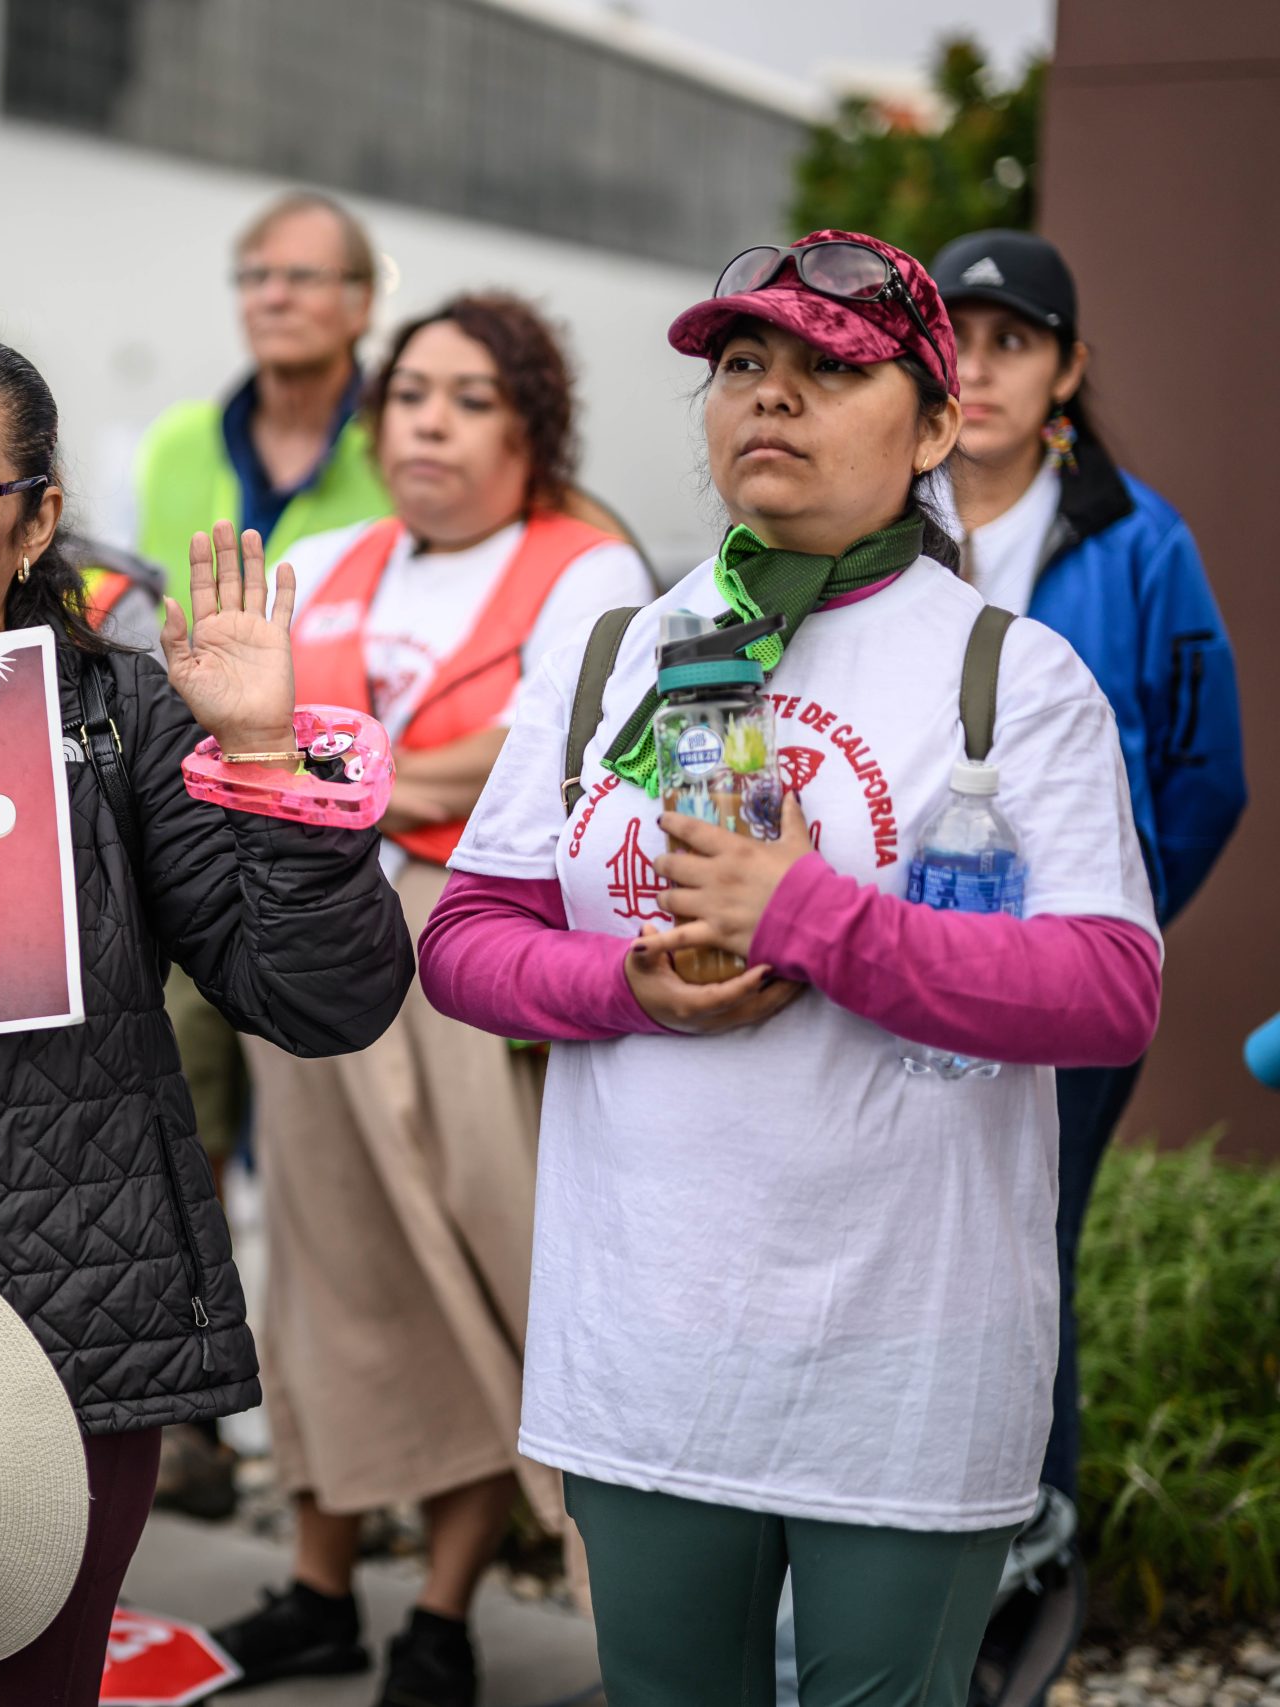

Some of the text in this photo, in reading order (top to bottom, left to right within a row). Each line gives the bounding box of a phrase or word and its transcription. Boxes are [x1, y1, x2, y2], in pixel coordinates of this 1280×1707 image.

[569, 773, 621, 858] COALIC
[797, 701, 838, 735] DE
[830, 724, 898, 869] CALIFORNIA
